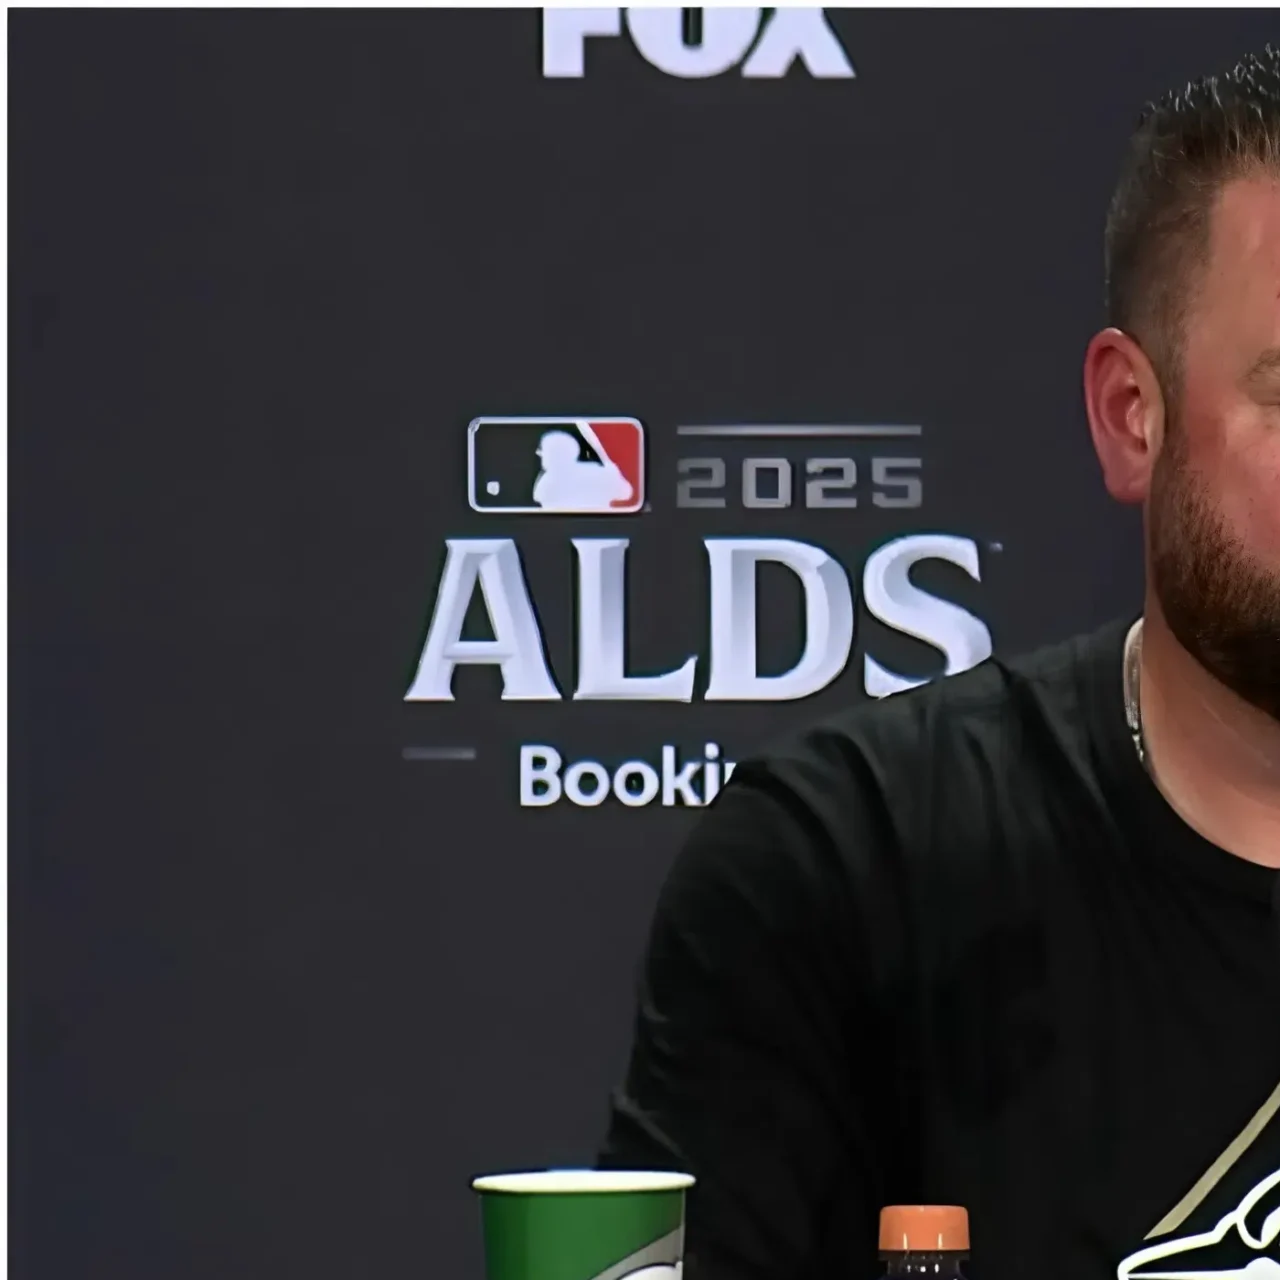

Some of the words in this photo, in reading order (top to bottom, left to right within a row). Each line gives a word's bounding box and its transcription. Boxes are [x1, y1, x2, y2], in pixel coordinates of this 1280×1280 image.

[676, 457, 922, 508] 2025
[404, 534, 992, 699] ALDS
[519, 741, 736, 807] Booki
